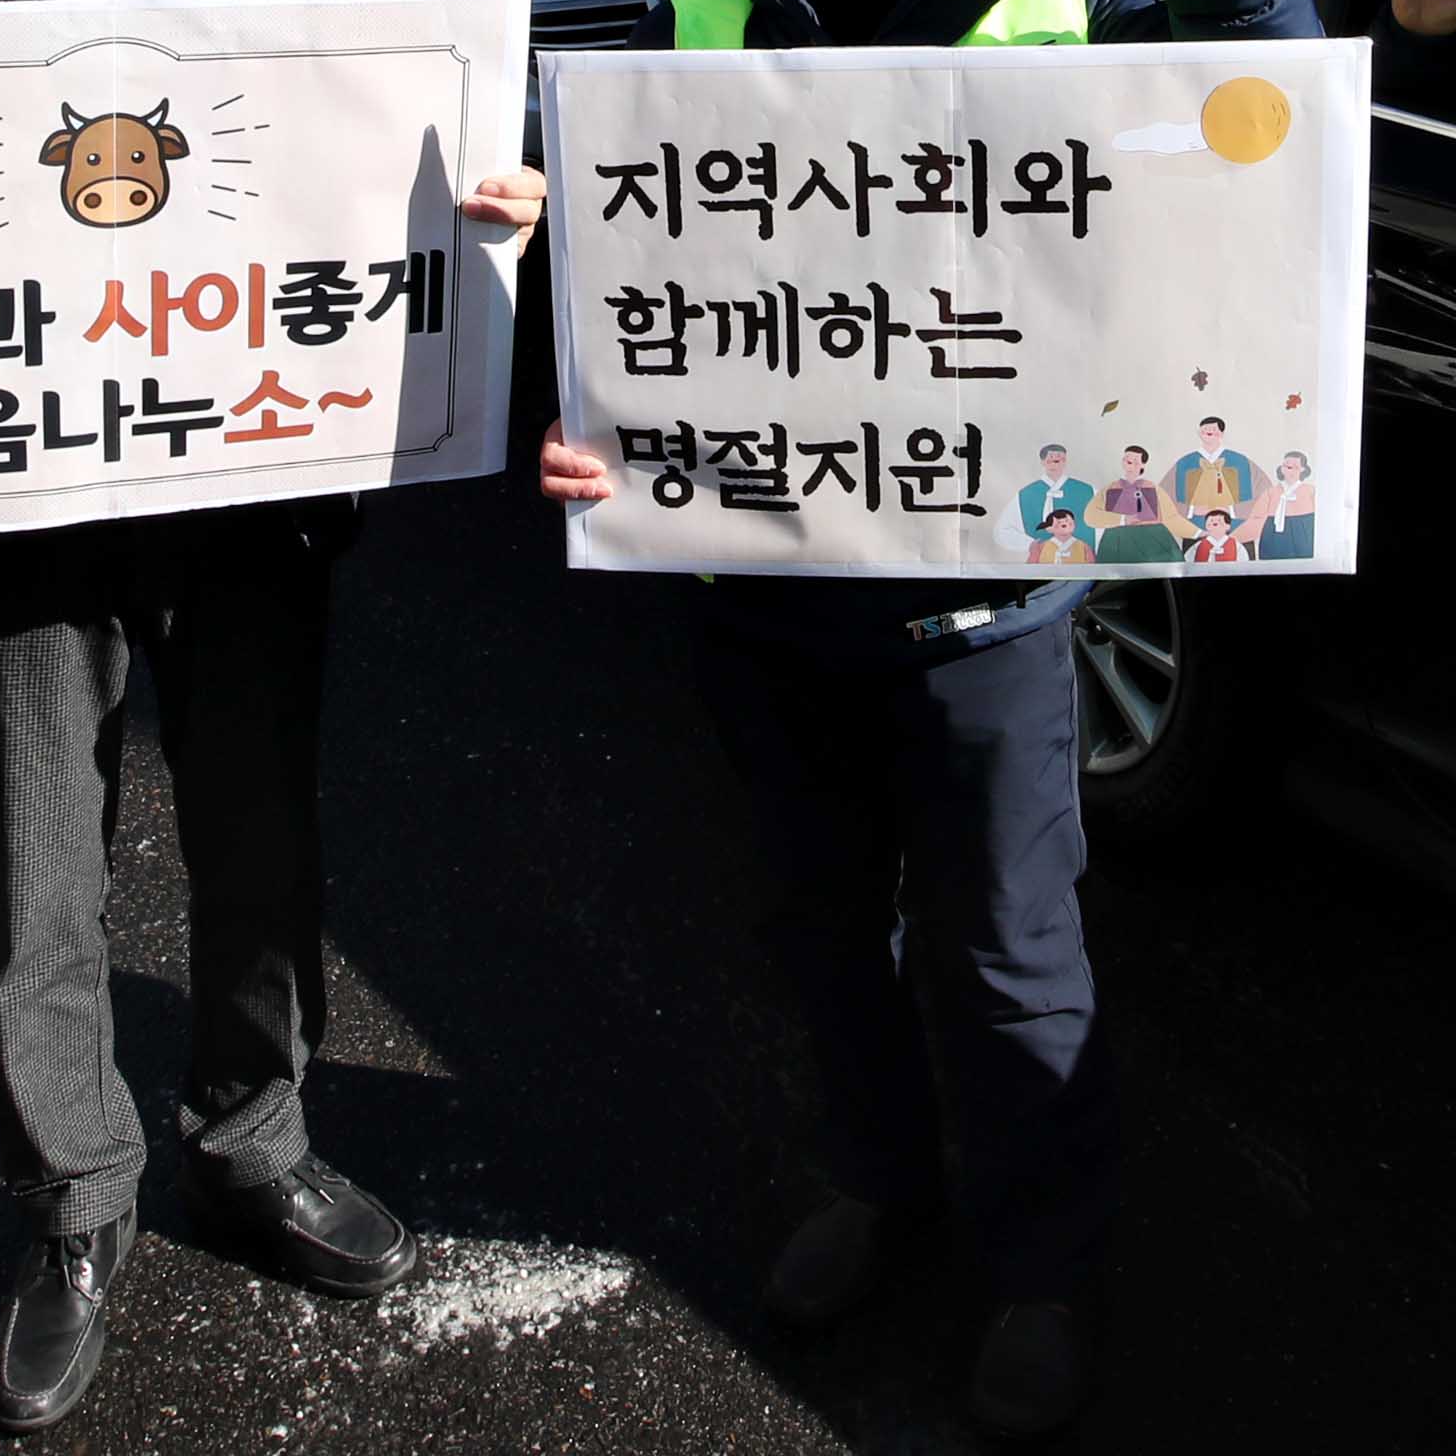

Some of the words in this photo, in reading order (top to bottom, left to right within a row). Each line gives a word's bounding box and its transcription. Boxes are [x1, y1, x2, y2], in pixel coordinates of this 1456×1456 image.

[593, 138, 1113, 242] 지역사회와
[82, 247, 446, 357] 사이좋게
[603, 281, 1024, 381] 함께하는
[615, 420, 988, 518] 명절지원
